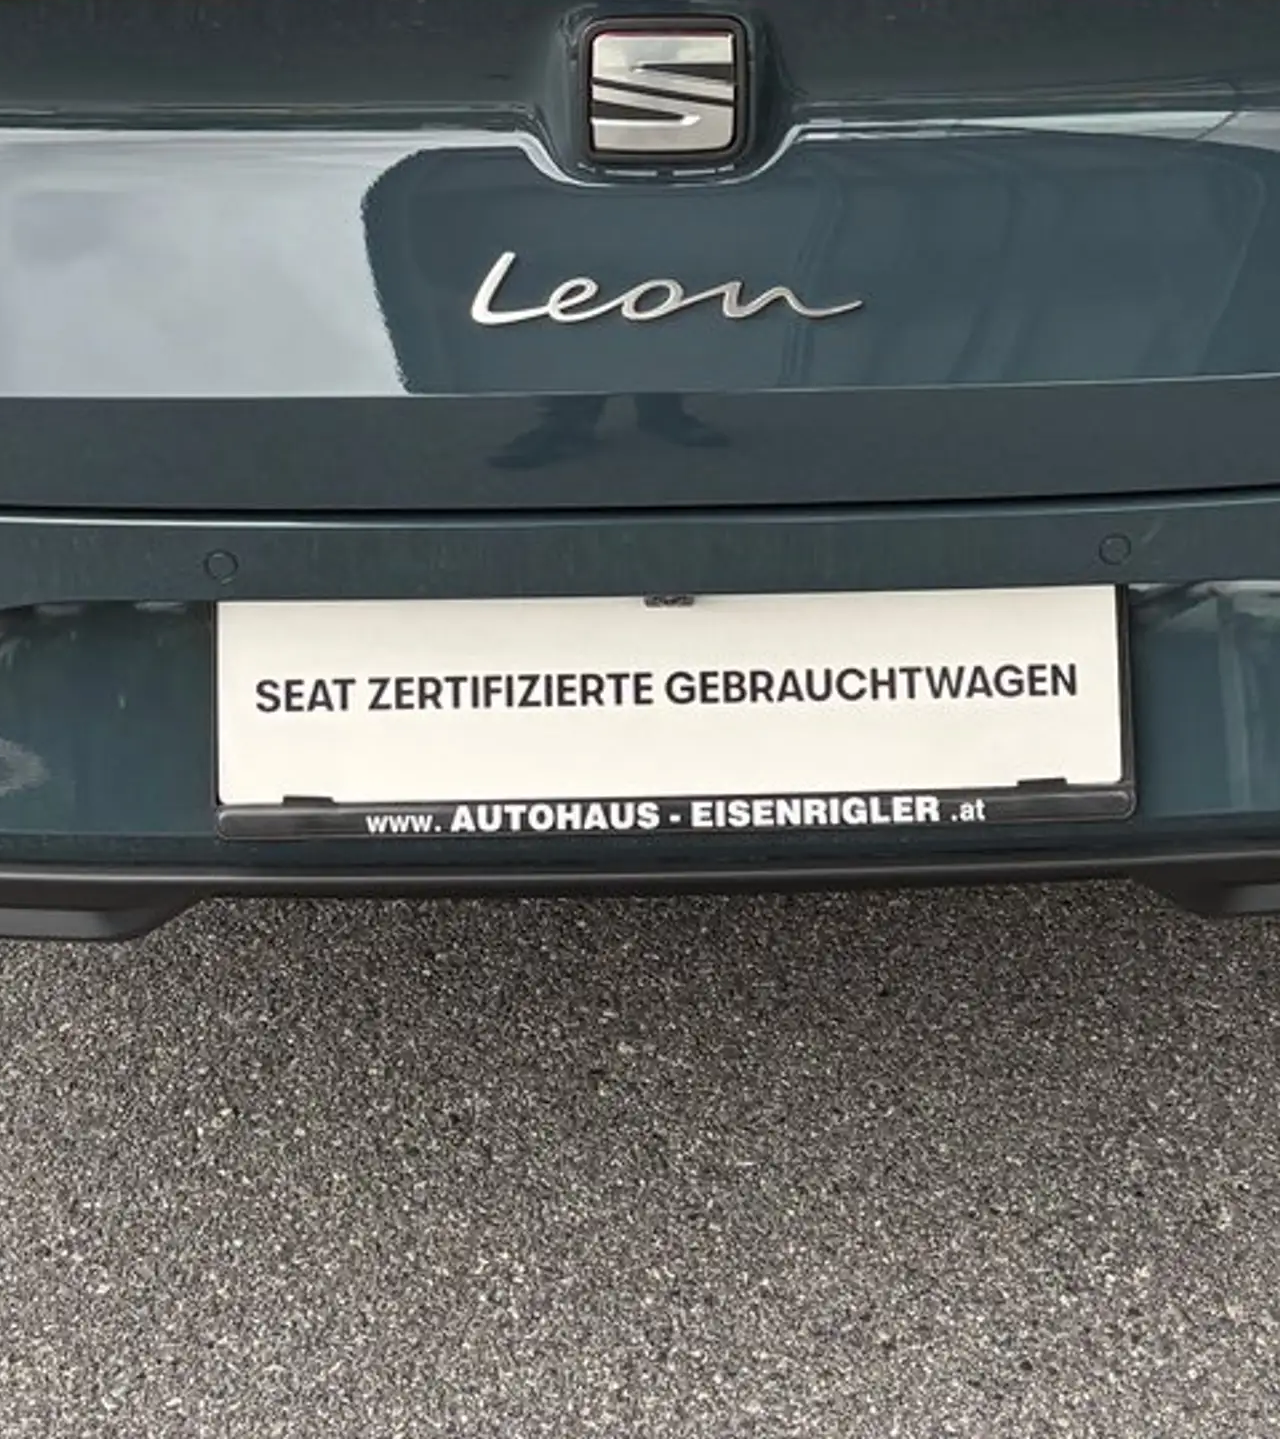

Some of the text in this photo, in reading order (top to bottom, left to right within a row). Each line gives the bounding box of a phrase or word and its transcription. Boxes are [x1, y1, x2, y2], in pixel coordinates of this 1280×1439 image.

[470, 250, 863, 326] Leon
[255, 662, 1077, 713] SEAT ZERTIFIZIERTE GEBRAUCHTWAGEN
[366, 813, 442, 833] www.
[449, 801, 661, 833] AUTOHAUS
[690, 794, 940, 828] EISENRIGLER
